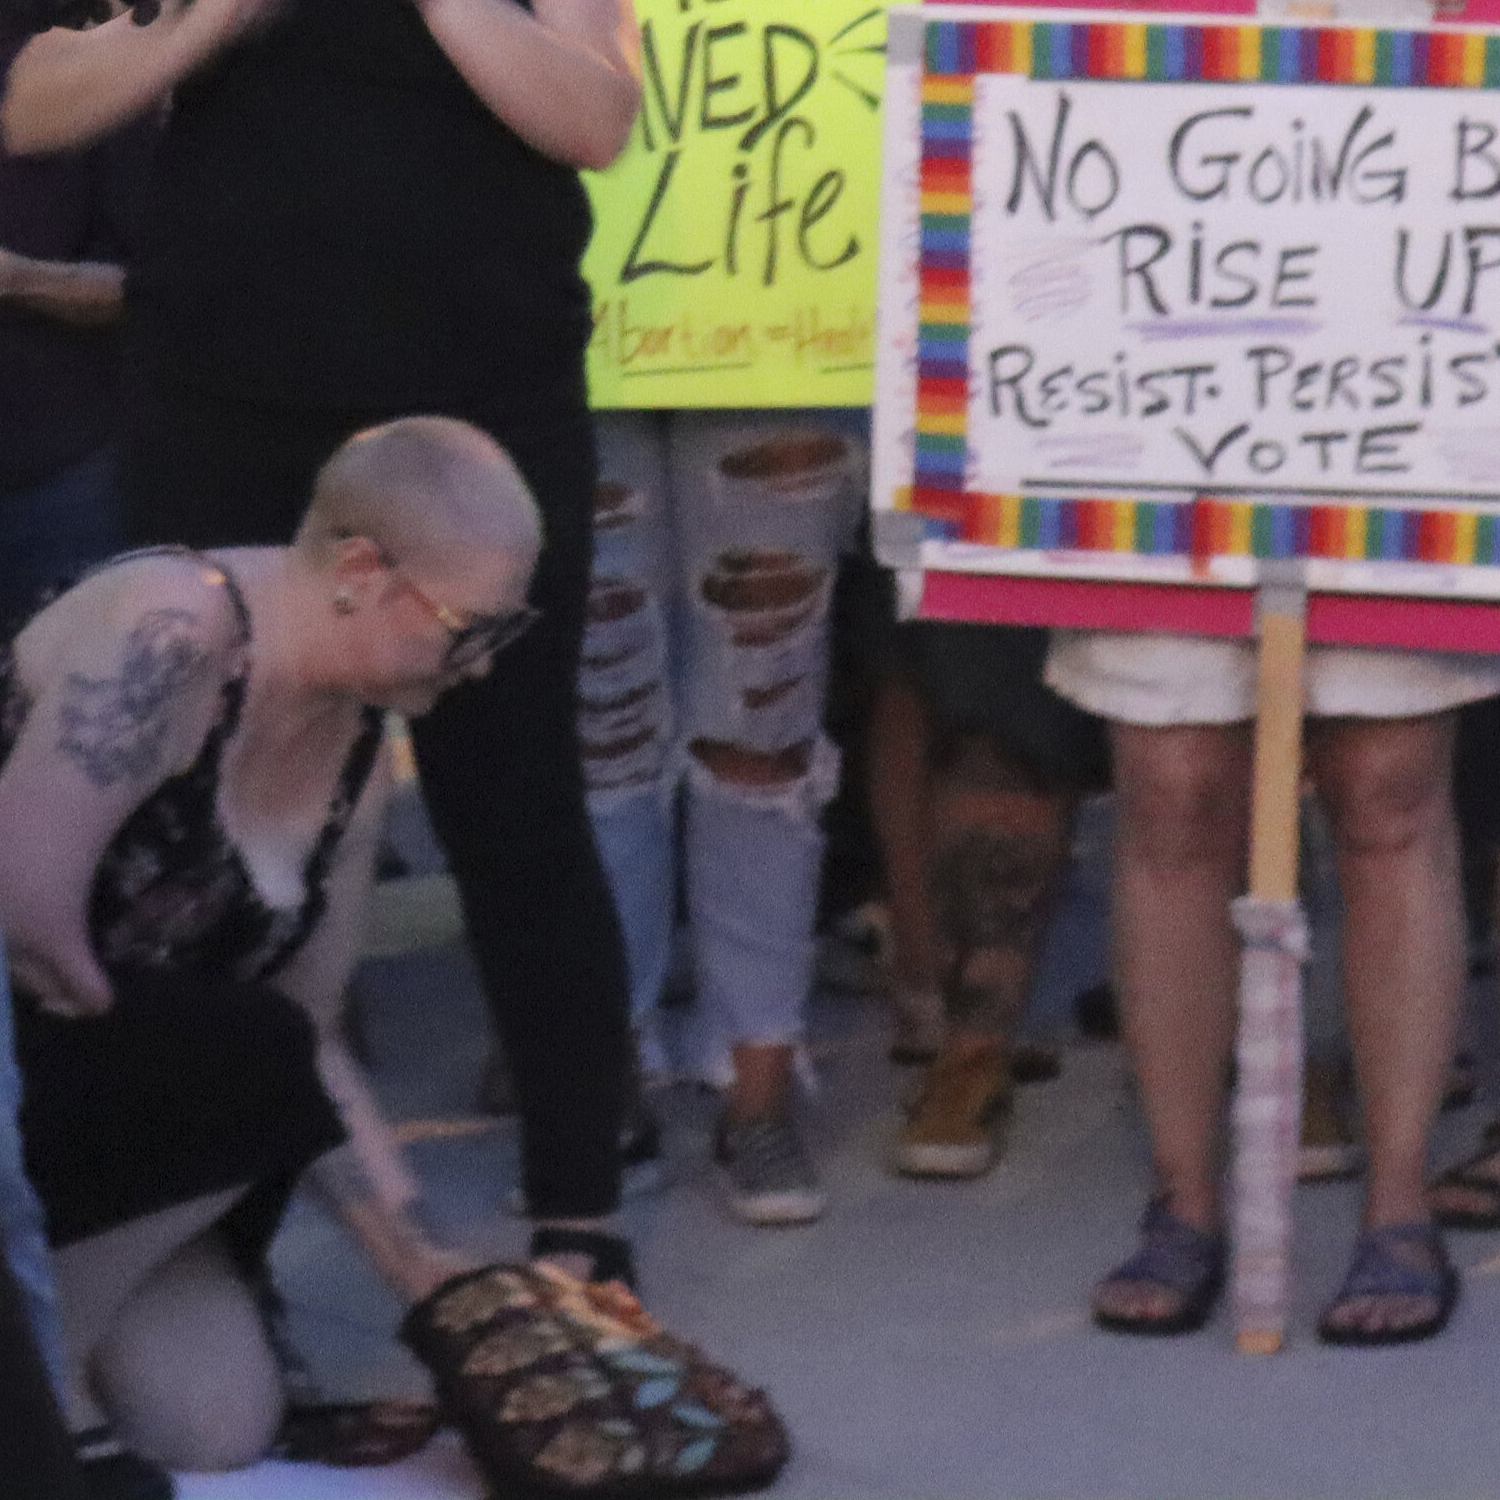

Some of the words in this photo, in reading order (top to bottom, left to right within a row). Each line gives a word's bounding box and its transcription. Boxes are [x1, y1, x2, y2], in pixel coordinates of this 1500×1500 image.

[641, 19, 820, 152] VED
[618, 116, 861, 287] Life
[1006, 89, 1121, 222] NO
[1394, 227, 1500, 315] UP
[1245, 333, 1500, 411] PERSIS
[1174, 422, 1423, 476] VOTE
